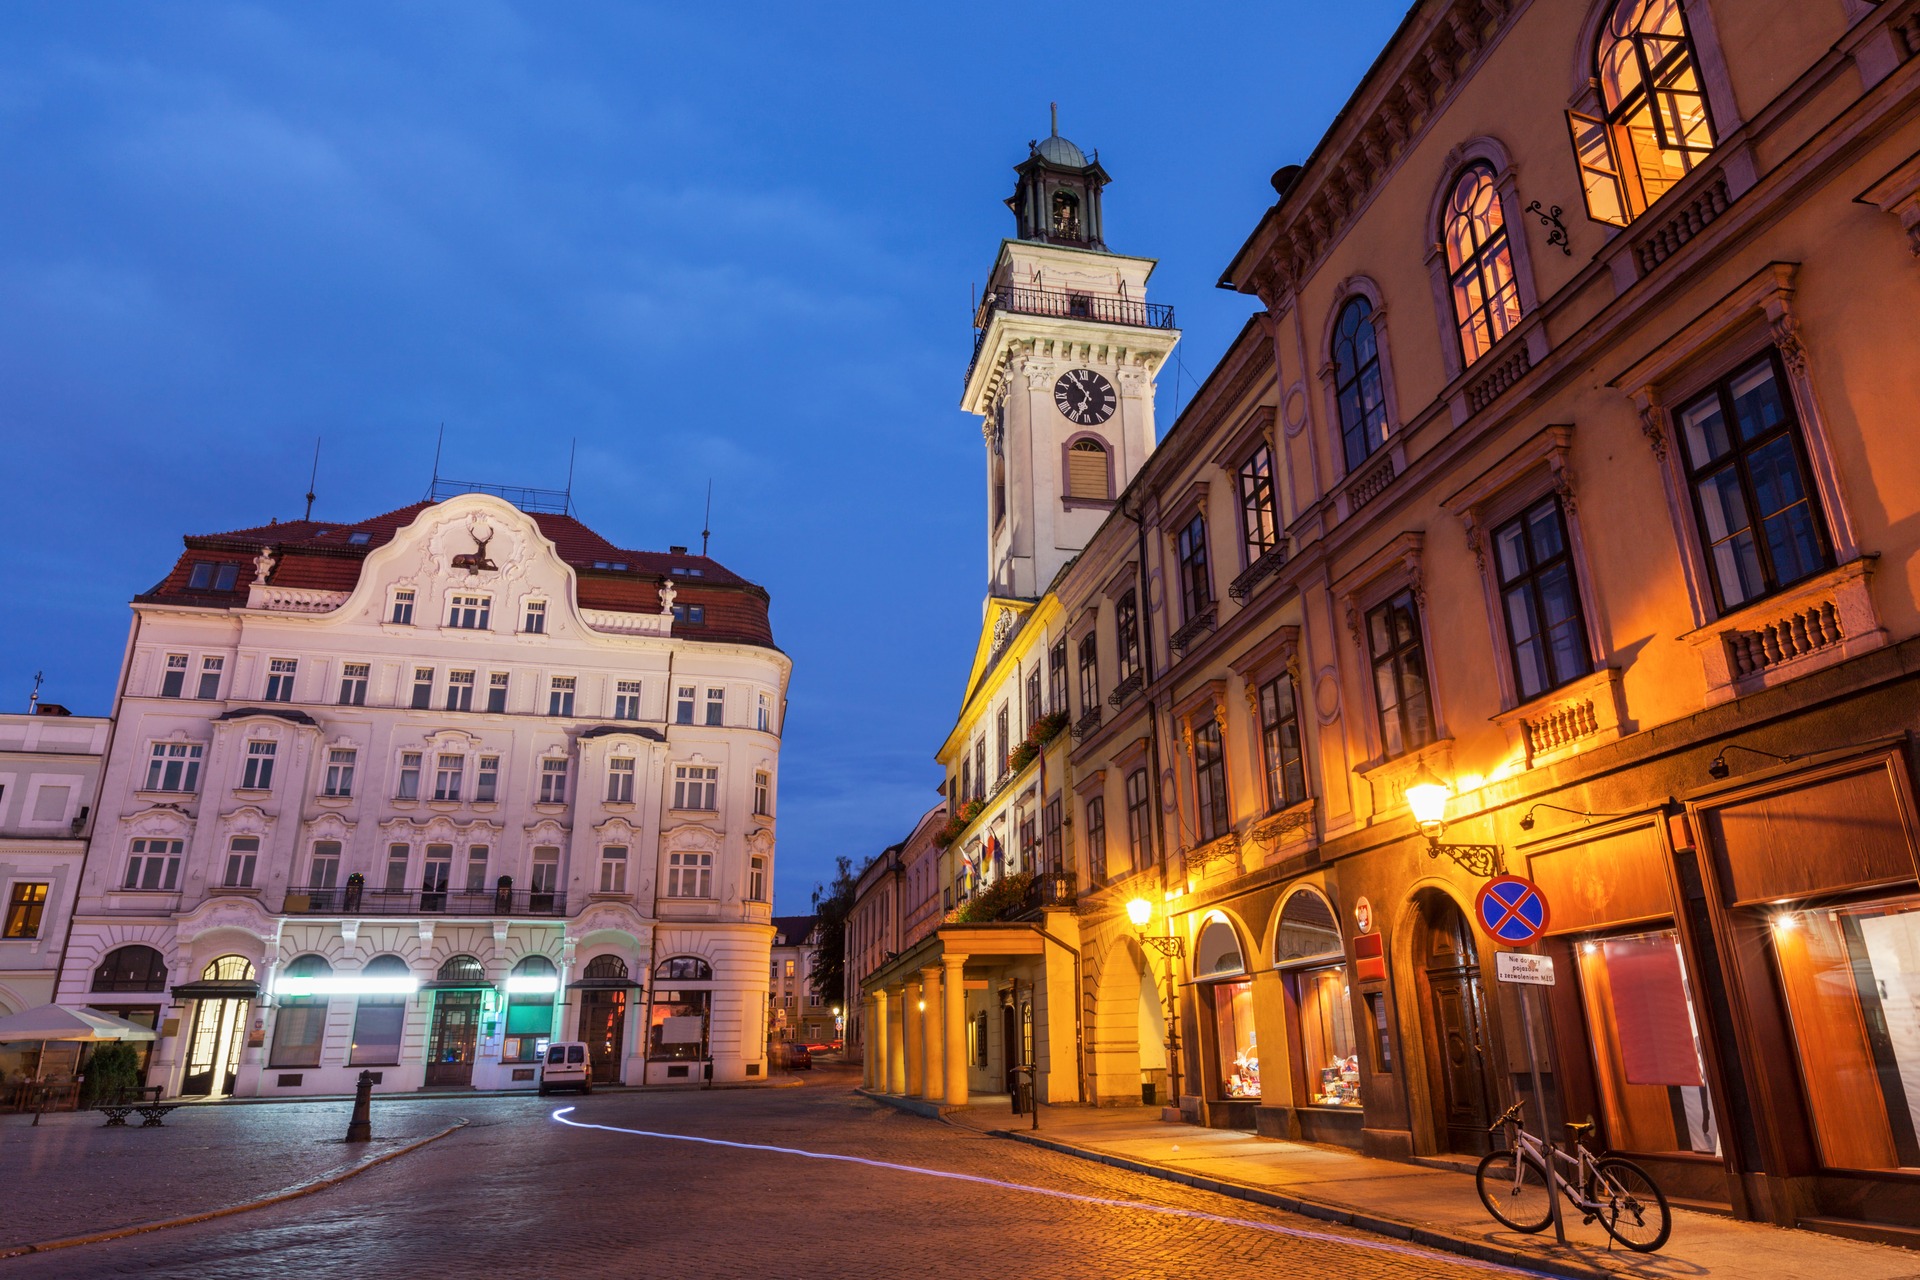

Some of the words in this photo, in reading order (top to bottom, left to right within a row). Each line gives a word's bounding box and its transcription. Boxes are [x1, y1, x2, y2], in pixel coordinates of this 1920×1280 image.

[1078, 370, 1088, 380] XII
[1093, 374, 1099, 383] I
[1057, 380, 1069, 390] X
[1100, 383, 1111, 392] II
[1055, 391, 1067, 399] IX
[1083, 414, 1091, 422] VI
[1095, 413, 1104, 422] V
